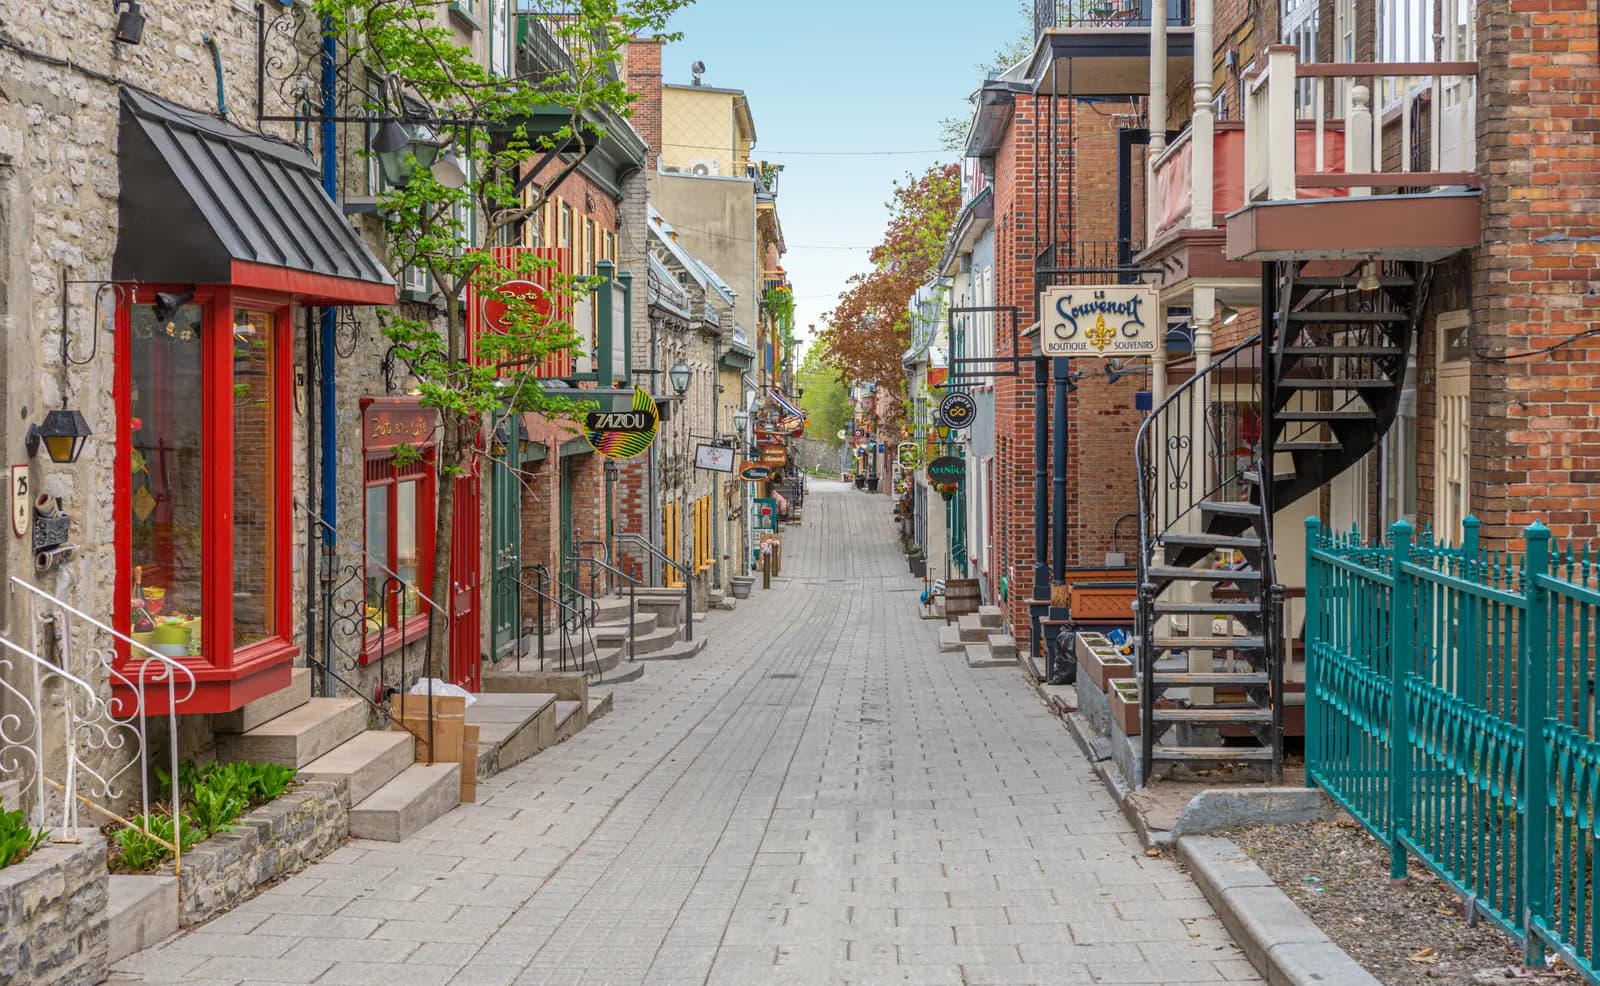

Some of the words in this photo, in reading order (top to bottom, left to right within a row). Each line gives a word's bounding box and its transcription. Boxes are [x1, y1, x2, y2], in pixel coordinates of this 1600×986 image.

[1093, 290, 1105, 300] LE
[1048, 342, 1089, 351] BOUTIQUE
[1113, 340, 1154, 350] SOUVENIRS
[594, 413, 645, 429] ZAZOU
[17, 476, 28, 496] 25
